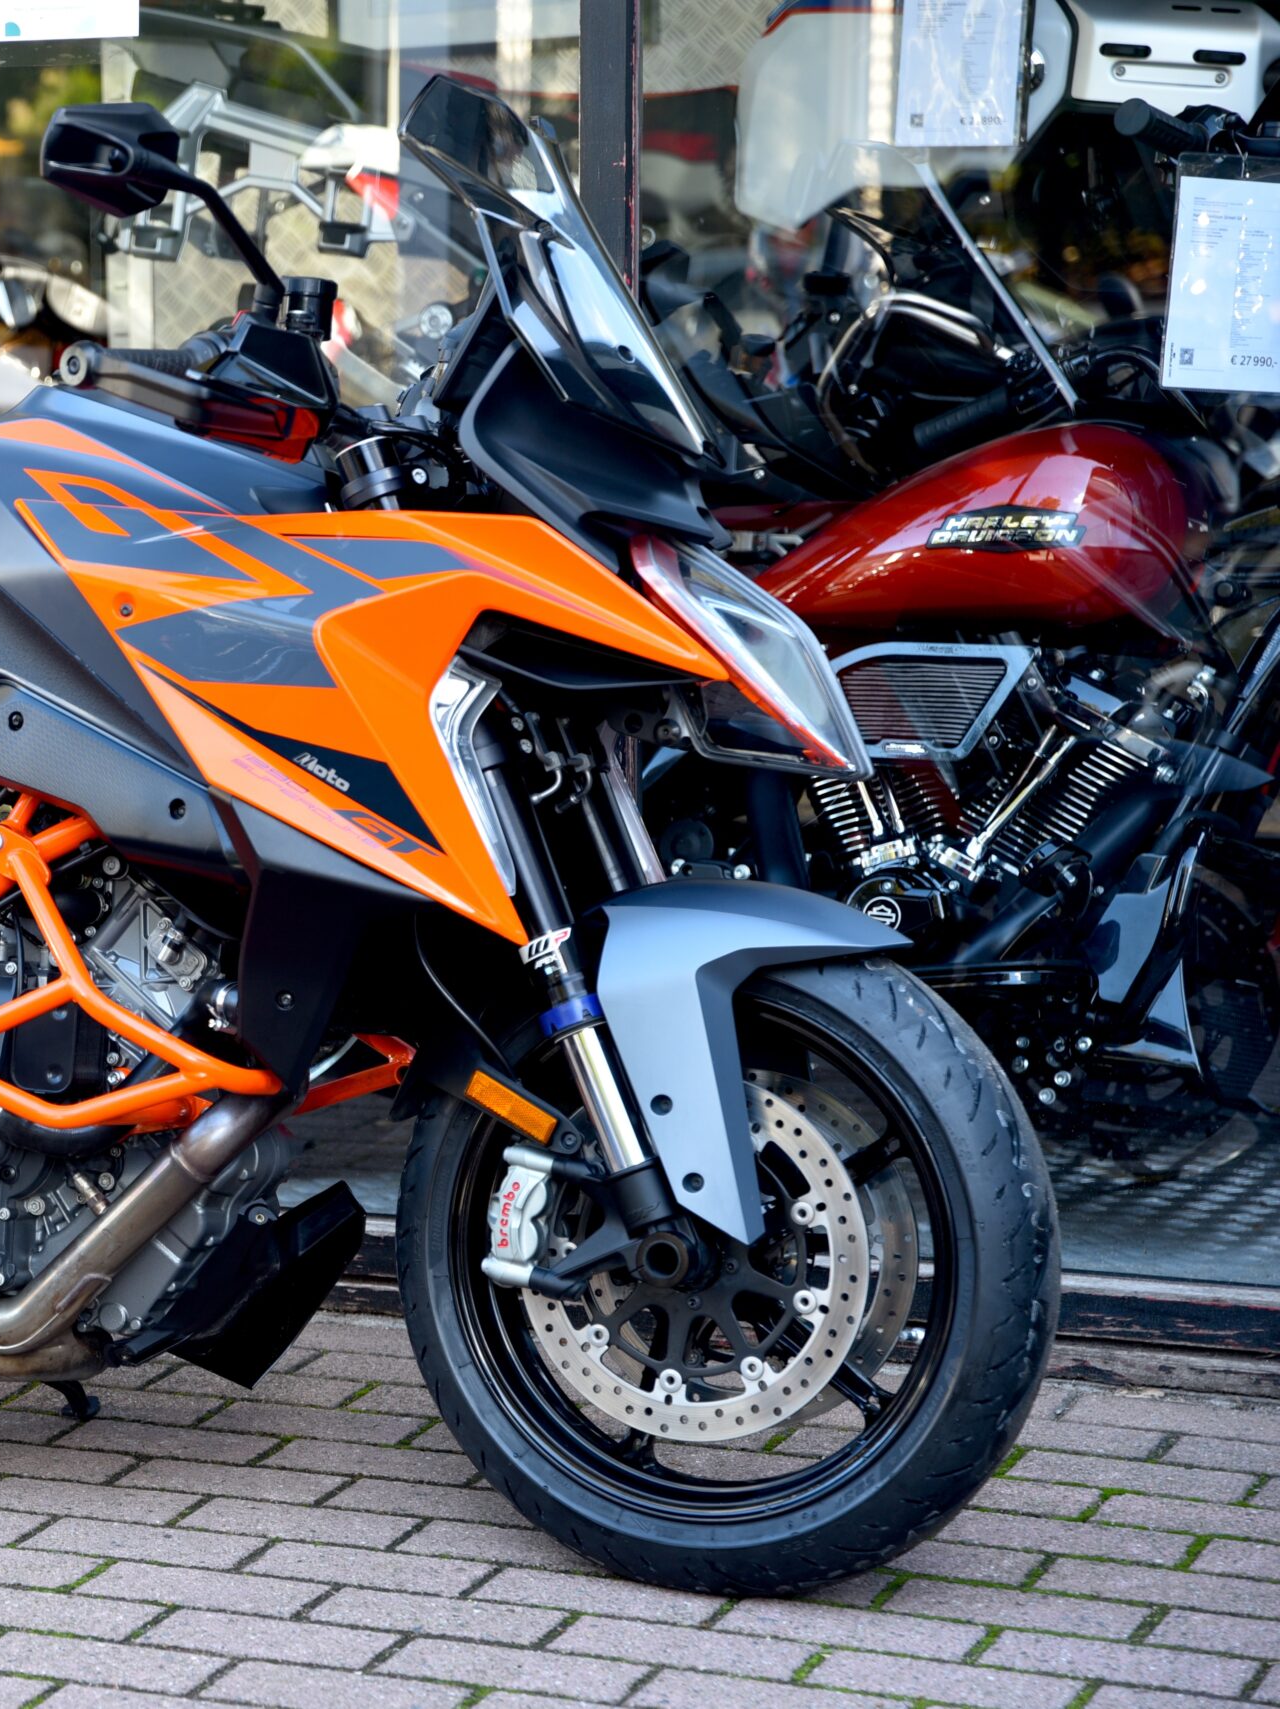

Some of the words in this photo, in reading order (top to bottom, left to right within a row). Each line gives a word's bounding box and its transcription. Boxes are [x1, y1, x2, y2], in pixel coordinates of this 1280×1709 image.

[1230, 354, 1238, 366] €
[931, 528, 1078, 545] DAVIDSON
[292, 752, 351, 792] Moto
[331, 808, 441, 857] GT
[497, 1181, 521, 1249] brembo
